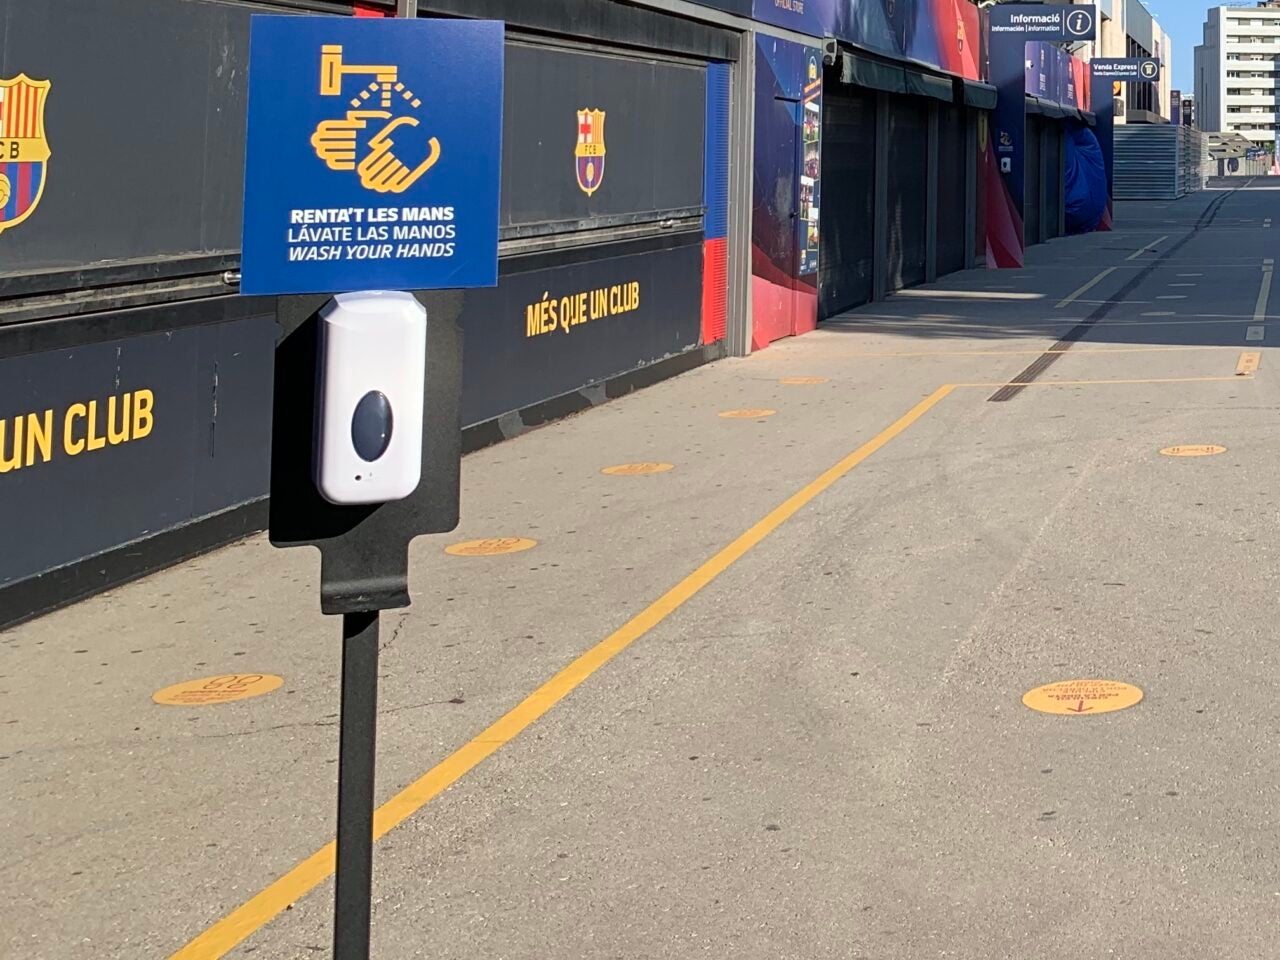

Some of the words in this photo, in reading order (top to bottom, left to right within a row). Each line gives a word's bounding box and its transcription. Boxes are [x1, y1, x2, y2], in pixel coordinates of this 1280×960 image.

[1010, 13, 1061, 23] Informació
[991, 24, 1025, 32] Información
[1028, 24, 1060, 32] Information
[1113, 63, 1138, 71] Express
[290, 207, 365, 224] RENTA'T
[367, 207, 399, 223] LES
[402, 206, 455, 222] MANS
[287, 223, 353, 243] LÁVATE
[357, 225, 389, 241] LAS
[393, 224, 456, 240] MANOS
[288, 245, 343, 262] WASH
[346, 244, 394, 260] YOUR
[395, 242, 456, 258] HANDS
[526, 290, 558, 338] MÉS
[560, 292, 588, 334] QUE
[590, 287, 609, 321] UN
[610, 280, 640, 316] CLUB
[0, 408, 54, 473] UN
[63, 388, 155, 457] CLUB
